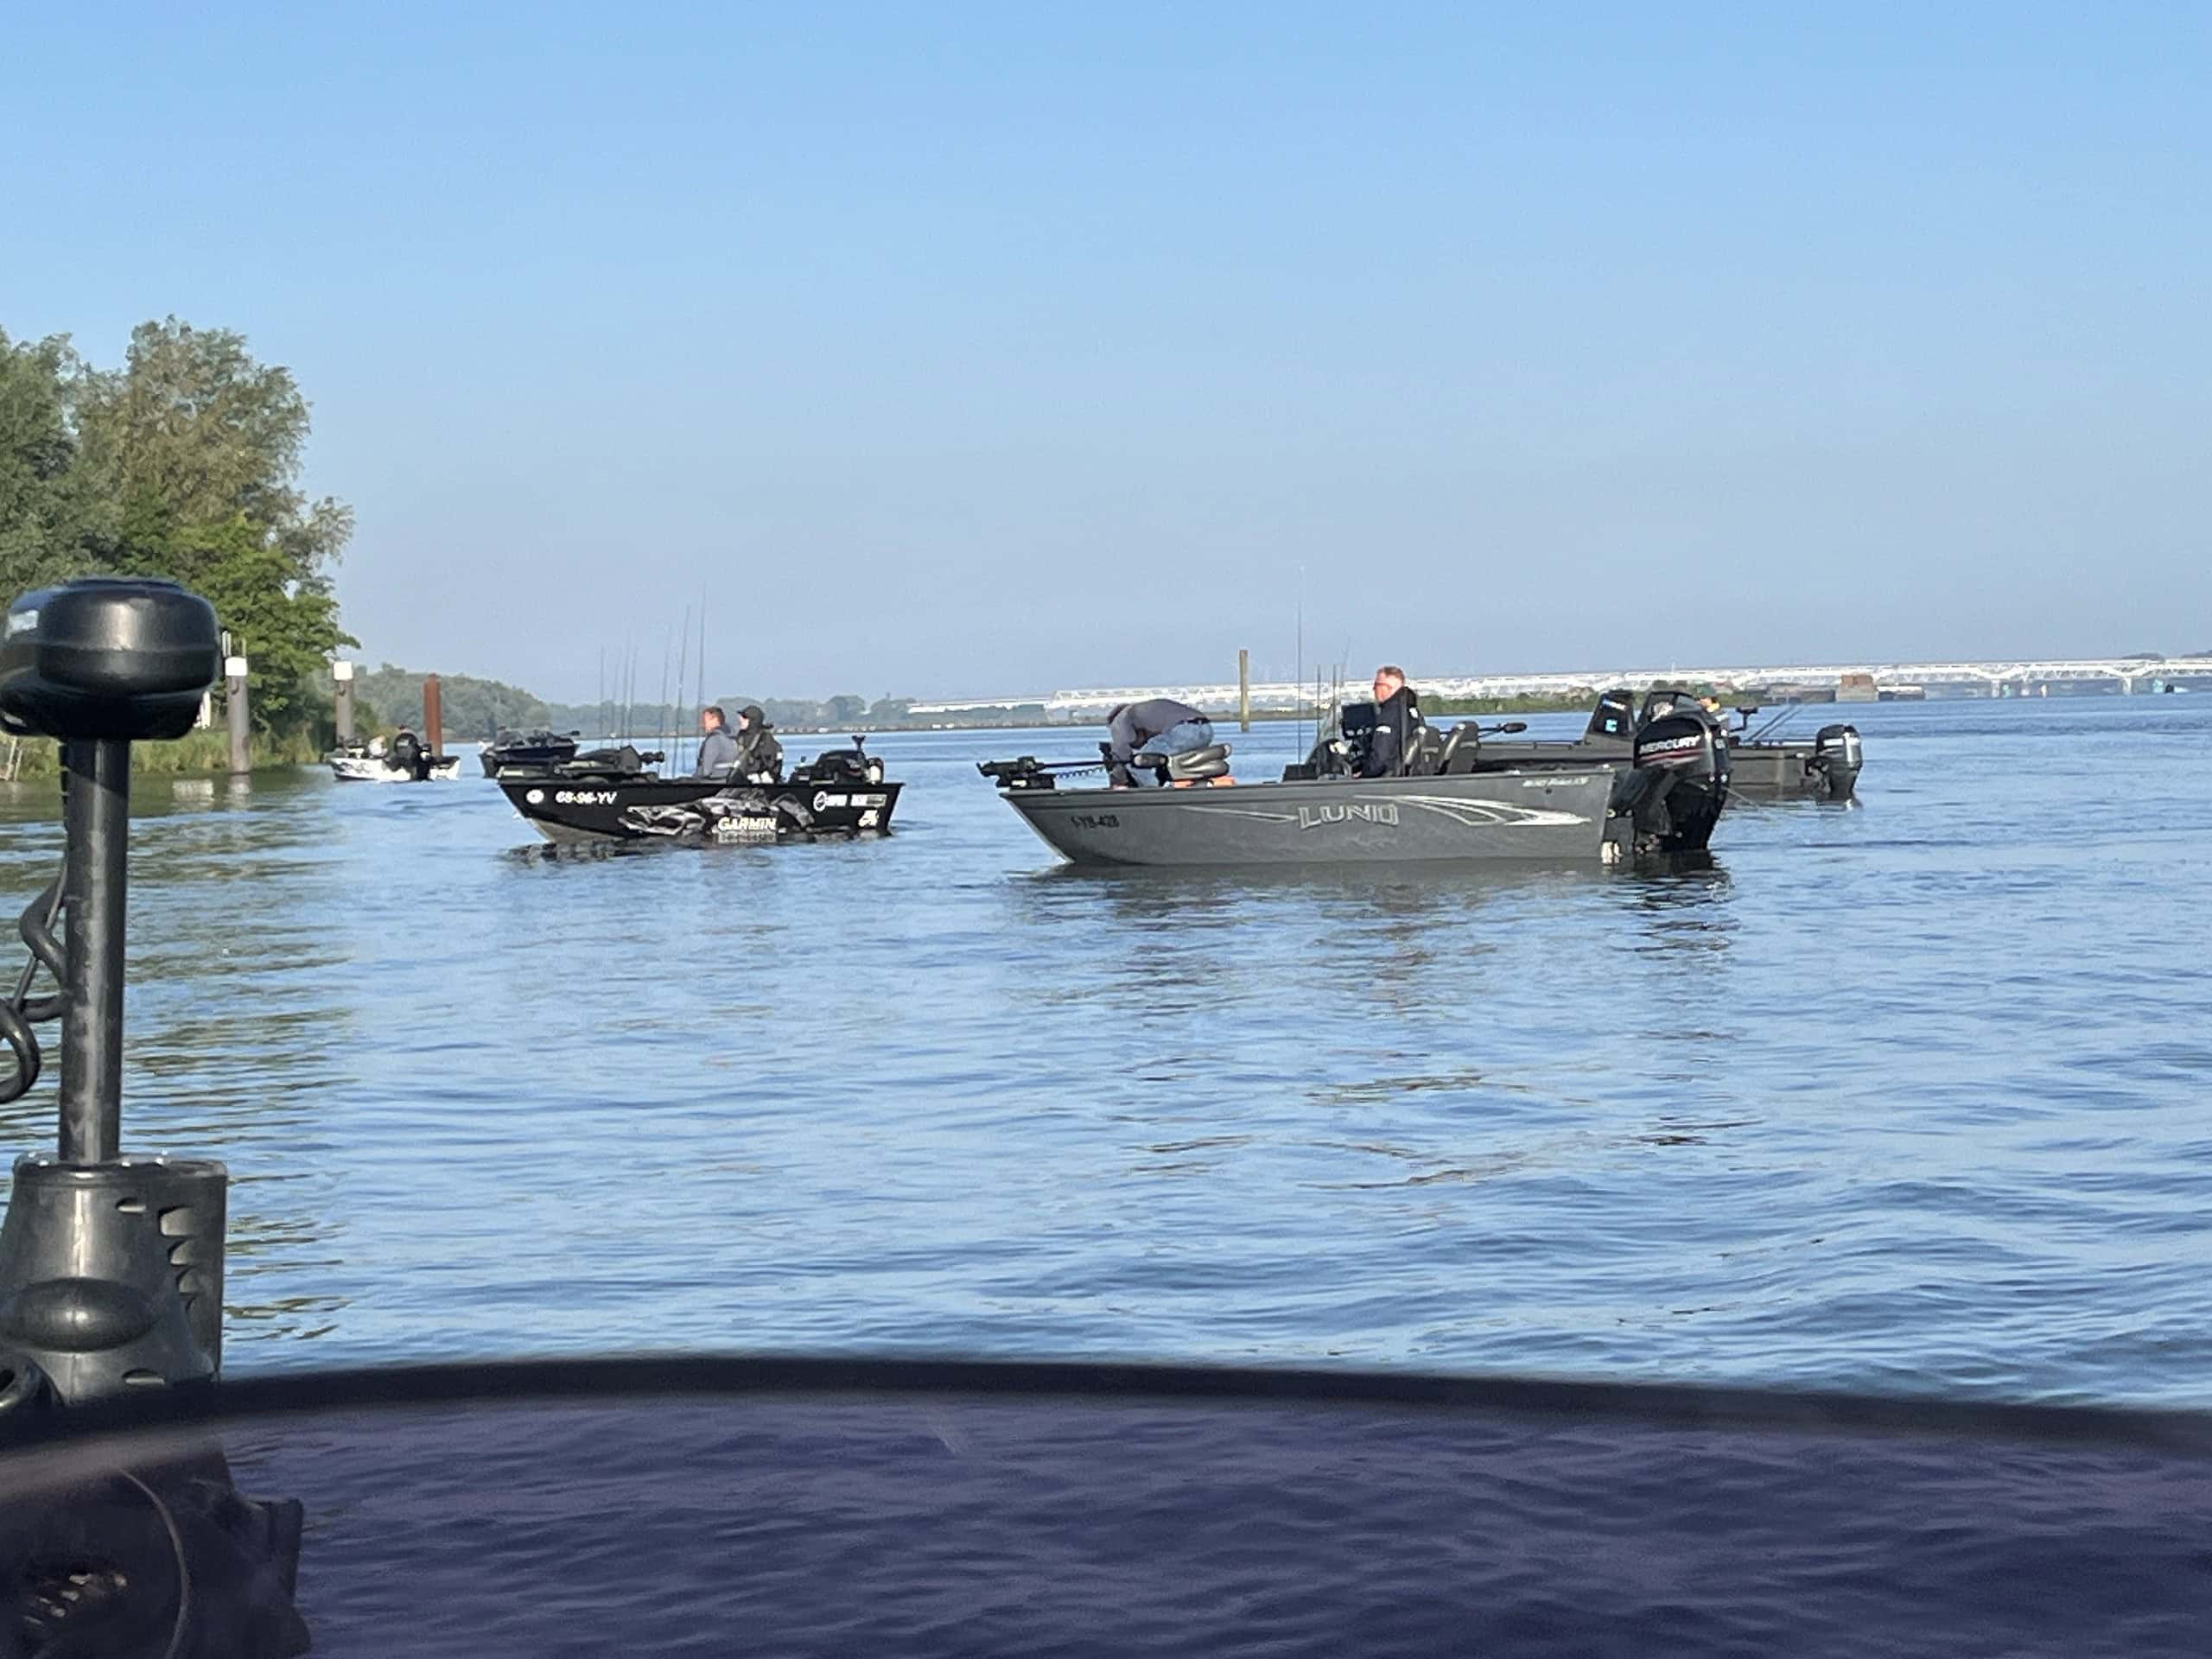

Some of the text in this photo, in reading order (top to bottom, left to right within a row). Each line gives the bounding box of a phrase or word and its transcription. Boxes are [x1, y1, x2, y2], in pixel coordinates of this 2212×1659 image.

[1639, 735, 1701, 754] MERCURY
[718, 817, 777, 830] GARMIN
[1298, 804, 1399, 829] LUND
